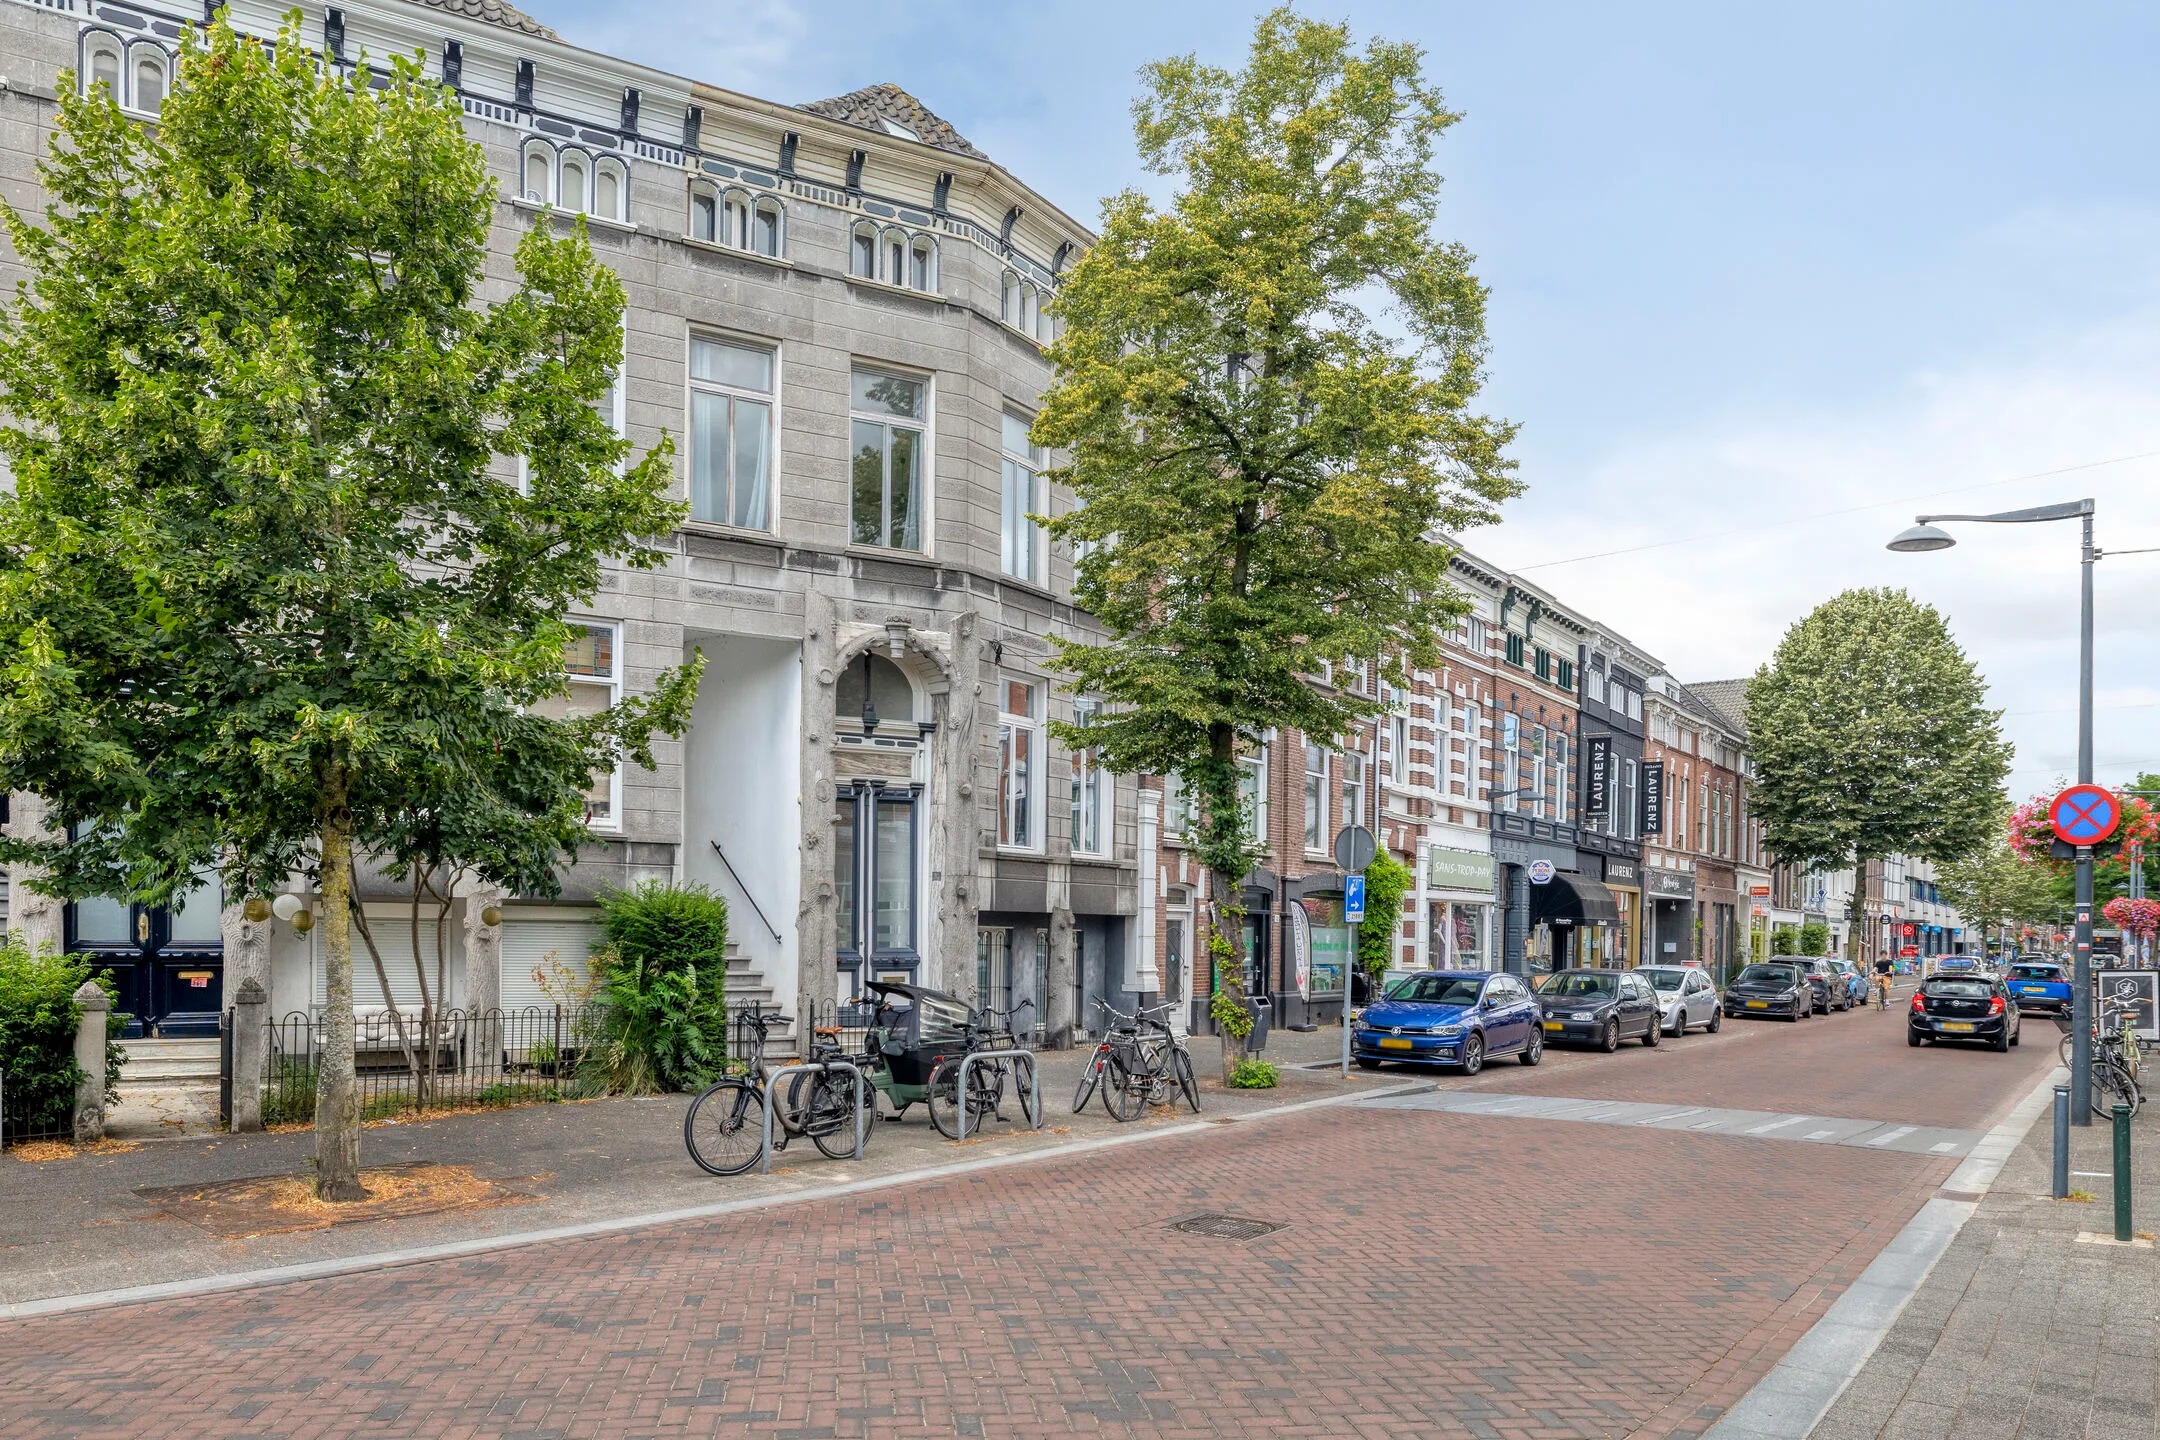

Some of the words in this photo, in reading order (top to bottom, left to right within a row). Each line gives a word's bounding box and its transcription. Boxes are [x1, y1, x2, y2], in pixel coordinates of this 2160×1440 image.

[1593, 742, 1605, 809] LAURENZ
[1647, 770, 1658, 830] LAURENZ
[1608, 863, 1633, 879] LAURENZ
